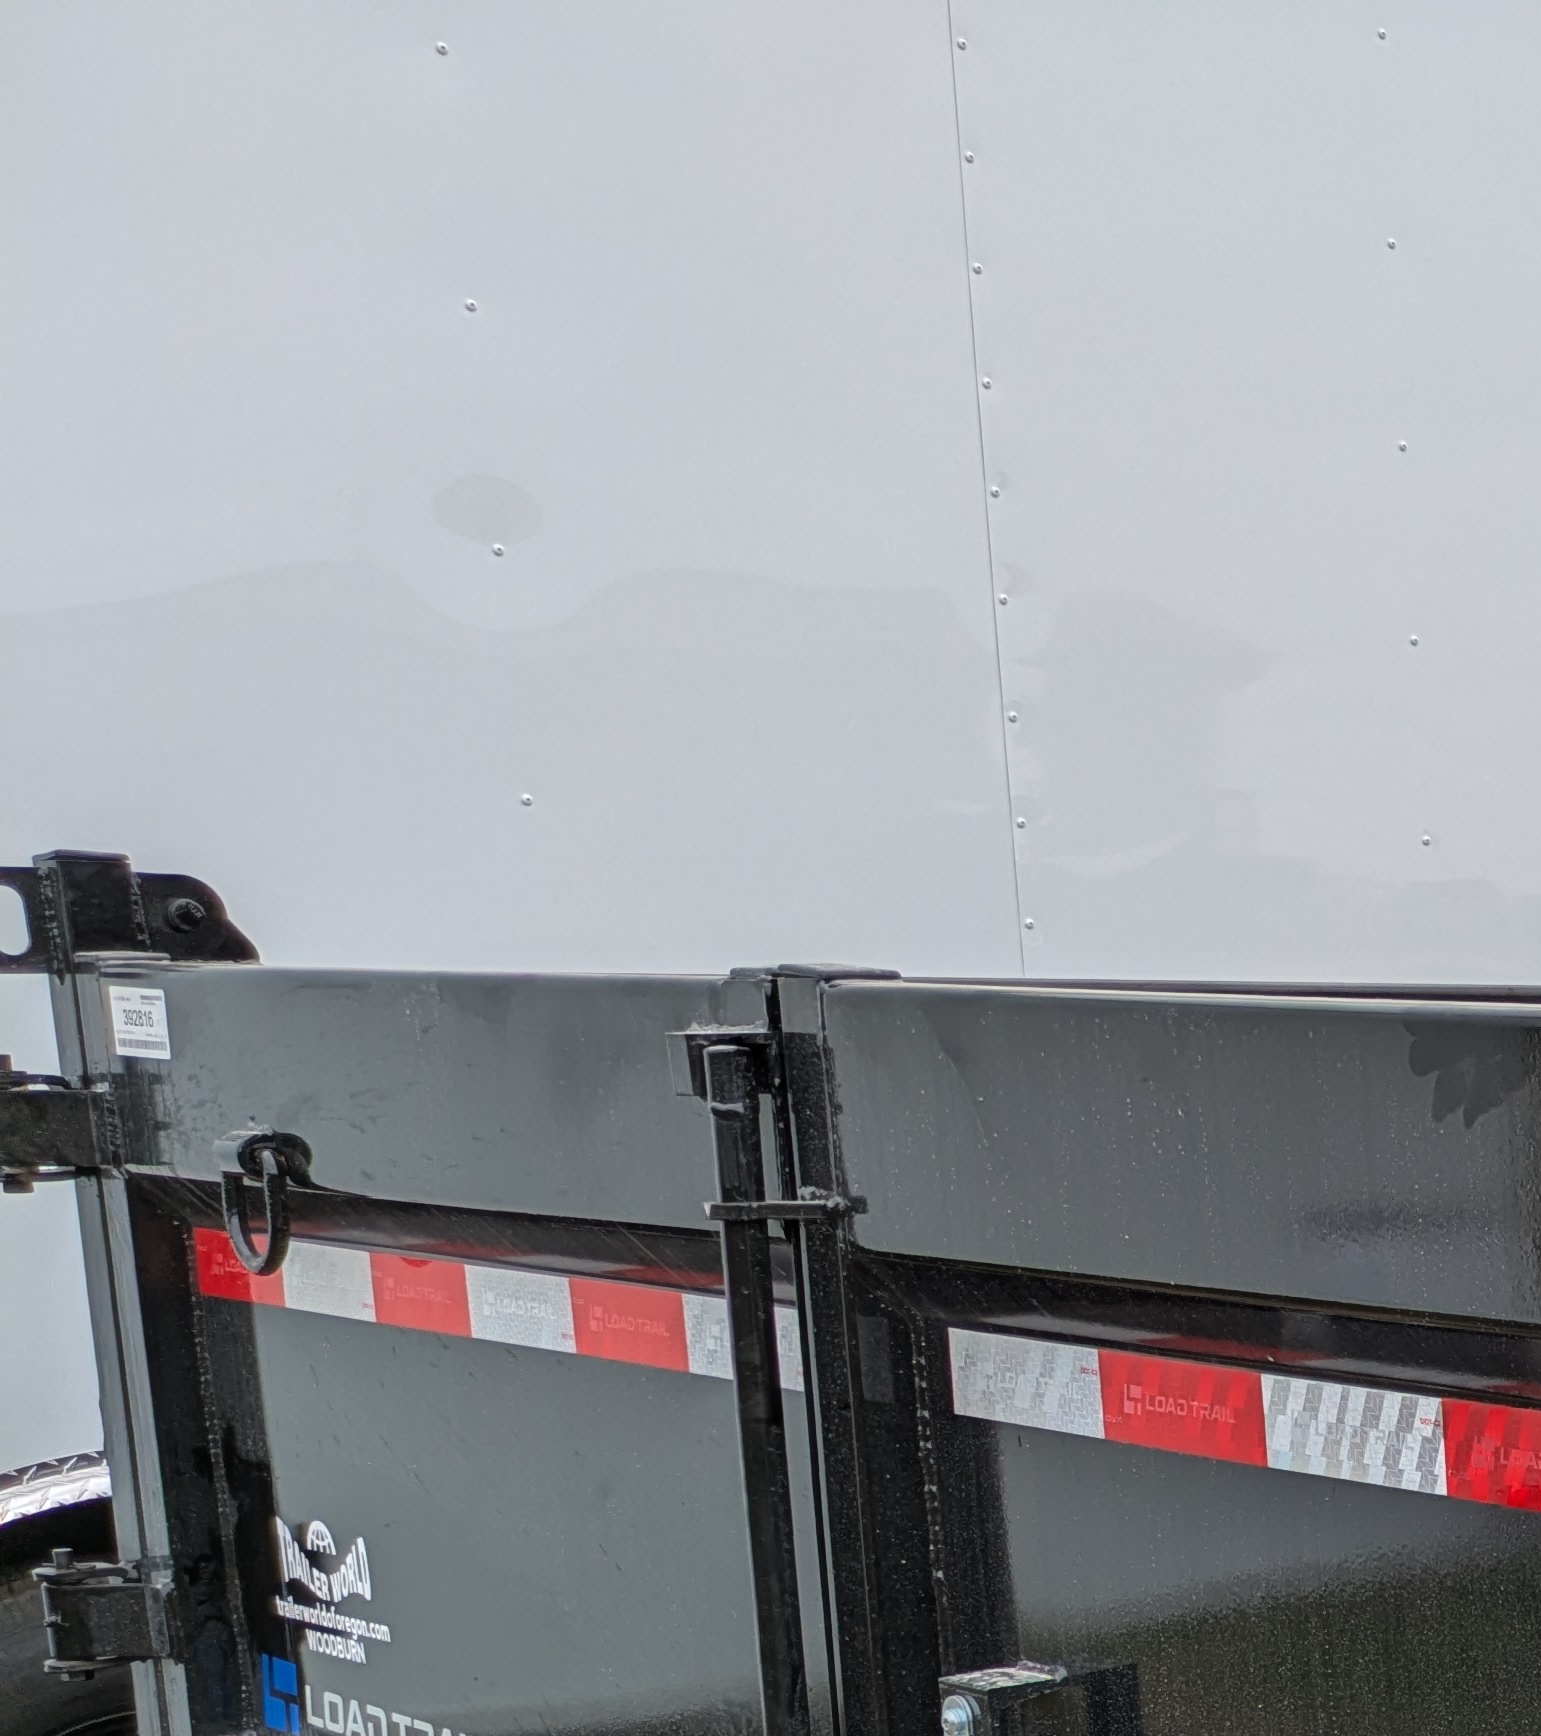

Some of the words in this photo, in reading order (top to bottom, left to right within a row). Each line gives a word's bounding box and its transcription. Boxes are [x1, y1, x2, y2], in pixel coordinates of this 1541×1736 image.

[275, 1515, 331, 1602] TRAILER
[330, 1536, 371, 1603] WORLD
[274, 1594, 391, 1643] trailerworldoforegon.com
[305, 1628, 367, 1664] WOODBURN
